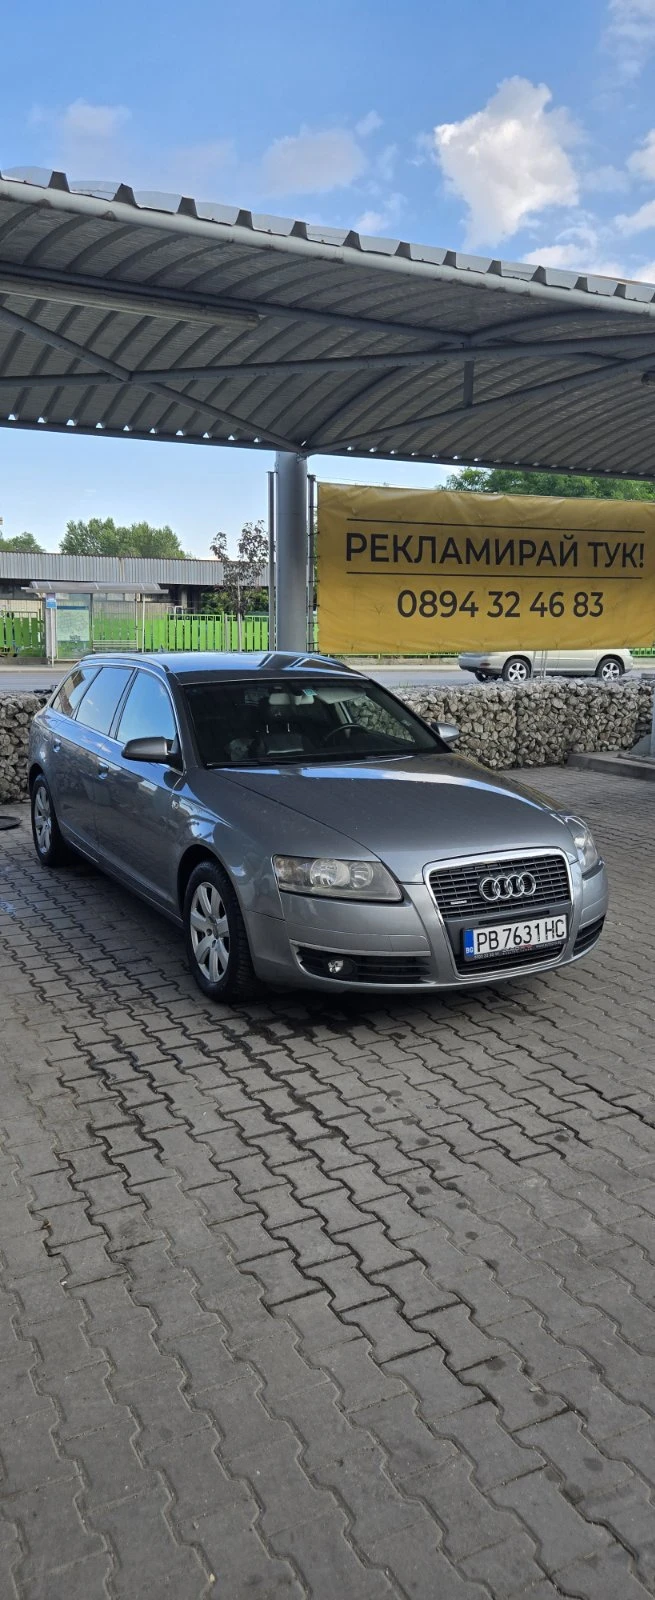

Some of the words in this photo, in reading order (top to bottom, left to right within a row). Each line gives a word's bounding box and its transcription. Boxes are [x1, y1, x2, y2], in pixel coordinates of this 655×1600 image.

[346, 533, 578, 567] РЕКЛАМИРАЙ
[588, 541, 645, 568] ТУК!
[397, 590, 479, 618] 0894
[487, 591, 520, 618] 32
[529, 591, 565, 618] 46
[573, 591, 604, 618] 83
[465, 946, 474, 954] BG
